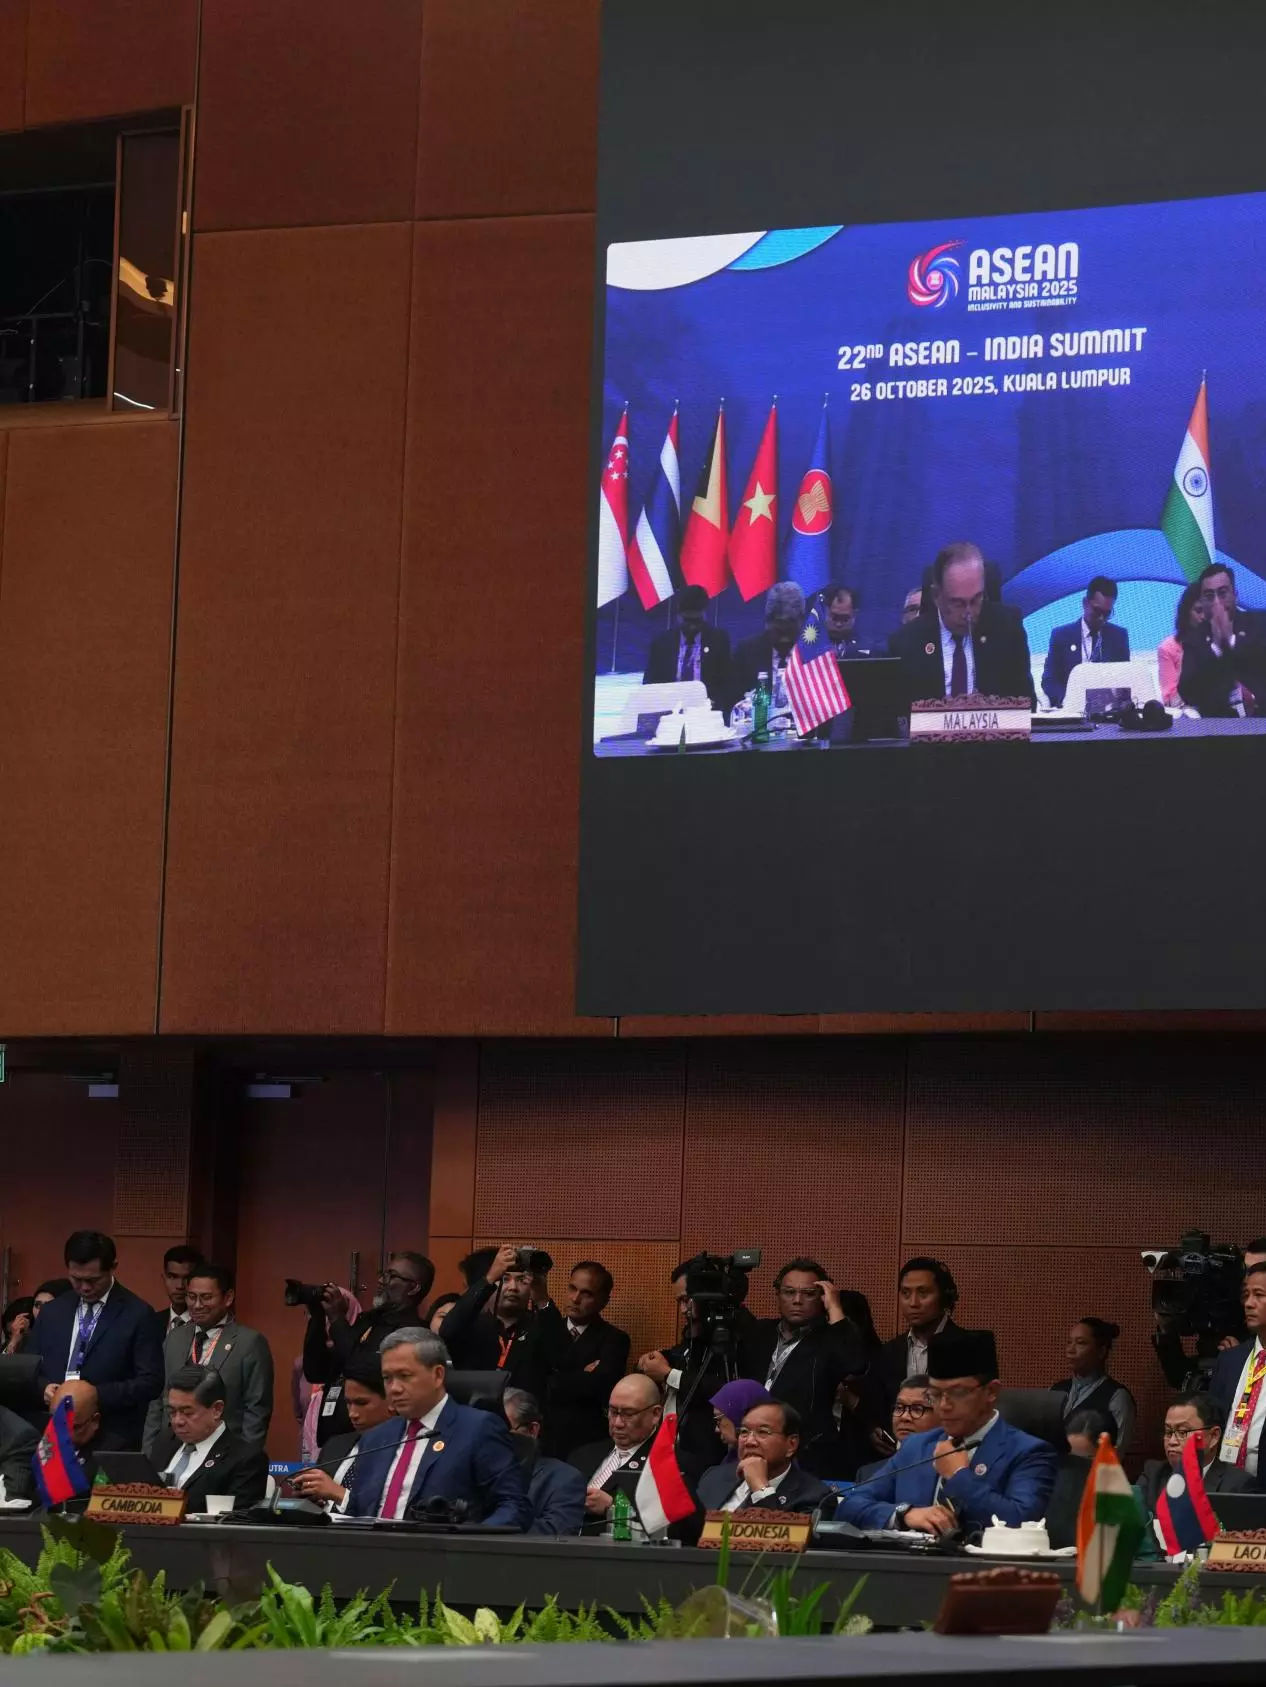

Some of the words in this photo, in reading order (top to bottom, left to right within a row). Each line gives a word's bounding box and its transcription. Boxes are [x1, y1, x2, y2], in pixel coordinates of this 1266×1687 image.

[968, 242, 1079, 285] ASEAN
[968, 283, 1038, 301] MALAYSIA
[1042, 280, 1078, 296] 2025
[968, 302, 1007, 311] INCLUSIVITY
[889, 340, 960, 367] ASEAN
[984, 334, 1043, 361] INDIA
[1050, 327, 1147, 357] SUMMIT
[850, 383, 871, 401] 26
[876, 378, 948, 400] OCTOBER
[952, 375, 998, 395] 2025,
[1003, 372, 1057, 392] KUALA
[1061, 367, 1131, 389] LUMPUR
[943, 712, 999, 729] MALAYSIA
[101, 1498, 162, 1514] CAMBODIA
[1233, 1545, 1261, 1560] LAO
